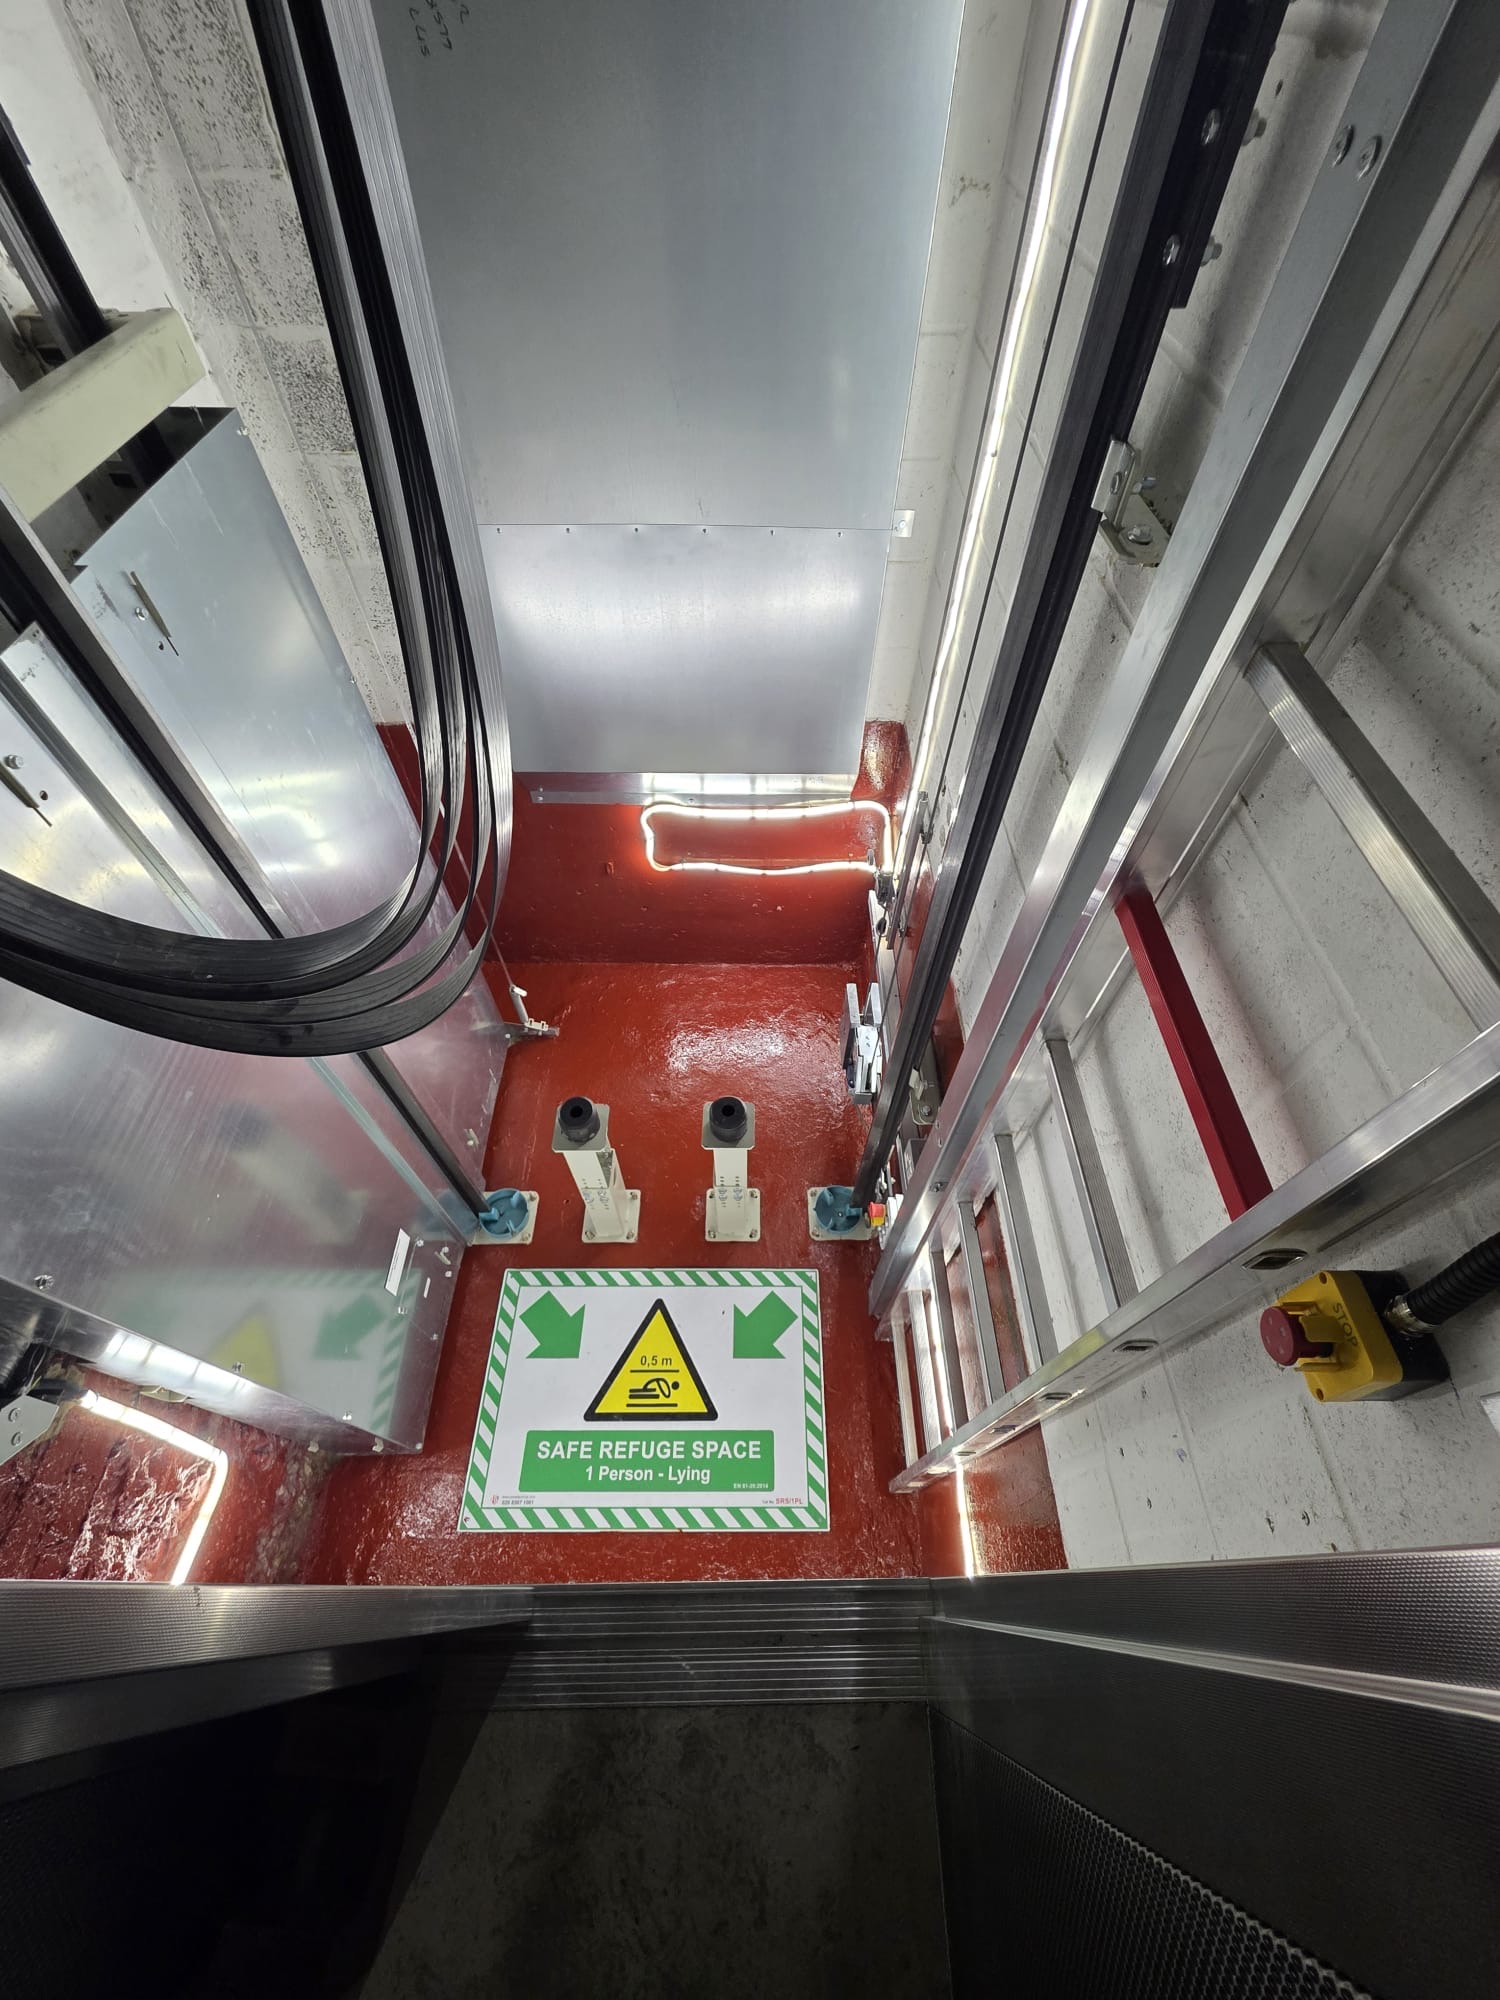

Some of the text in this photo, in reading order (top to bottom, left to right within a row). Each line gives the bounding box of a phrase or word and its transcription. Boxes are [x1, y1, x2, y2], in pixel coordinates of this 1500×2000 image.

[1332, 1302, 1358, 1347] STOP
[640, 1355, 673, 1368] 0,5 m
[537, 1440, 761, 1460] SAFE REFUGE SPACE
[585, 1465, 593, 1481] 1
[598, 1465, 654, 1481] Person
[668, 1465, 711, 1485] Lying
